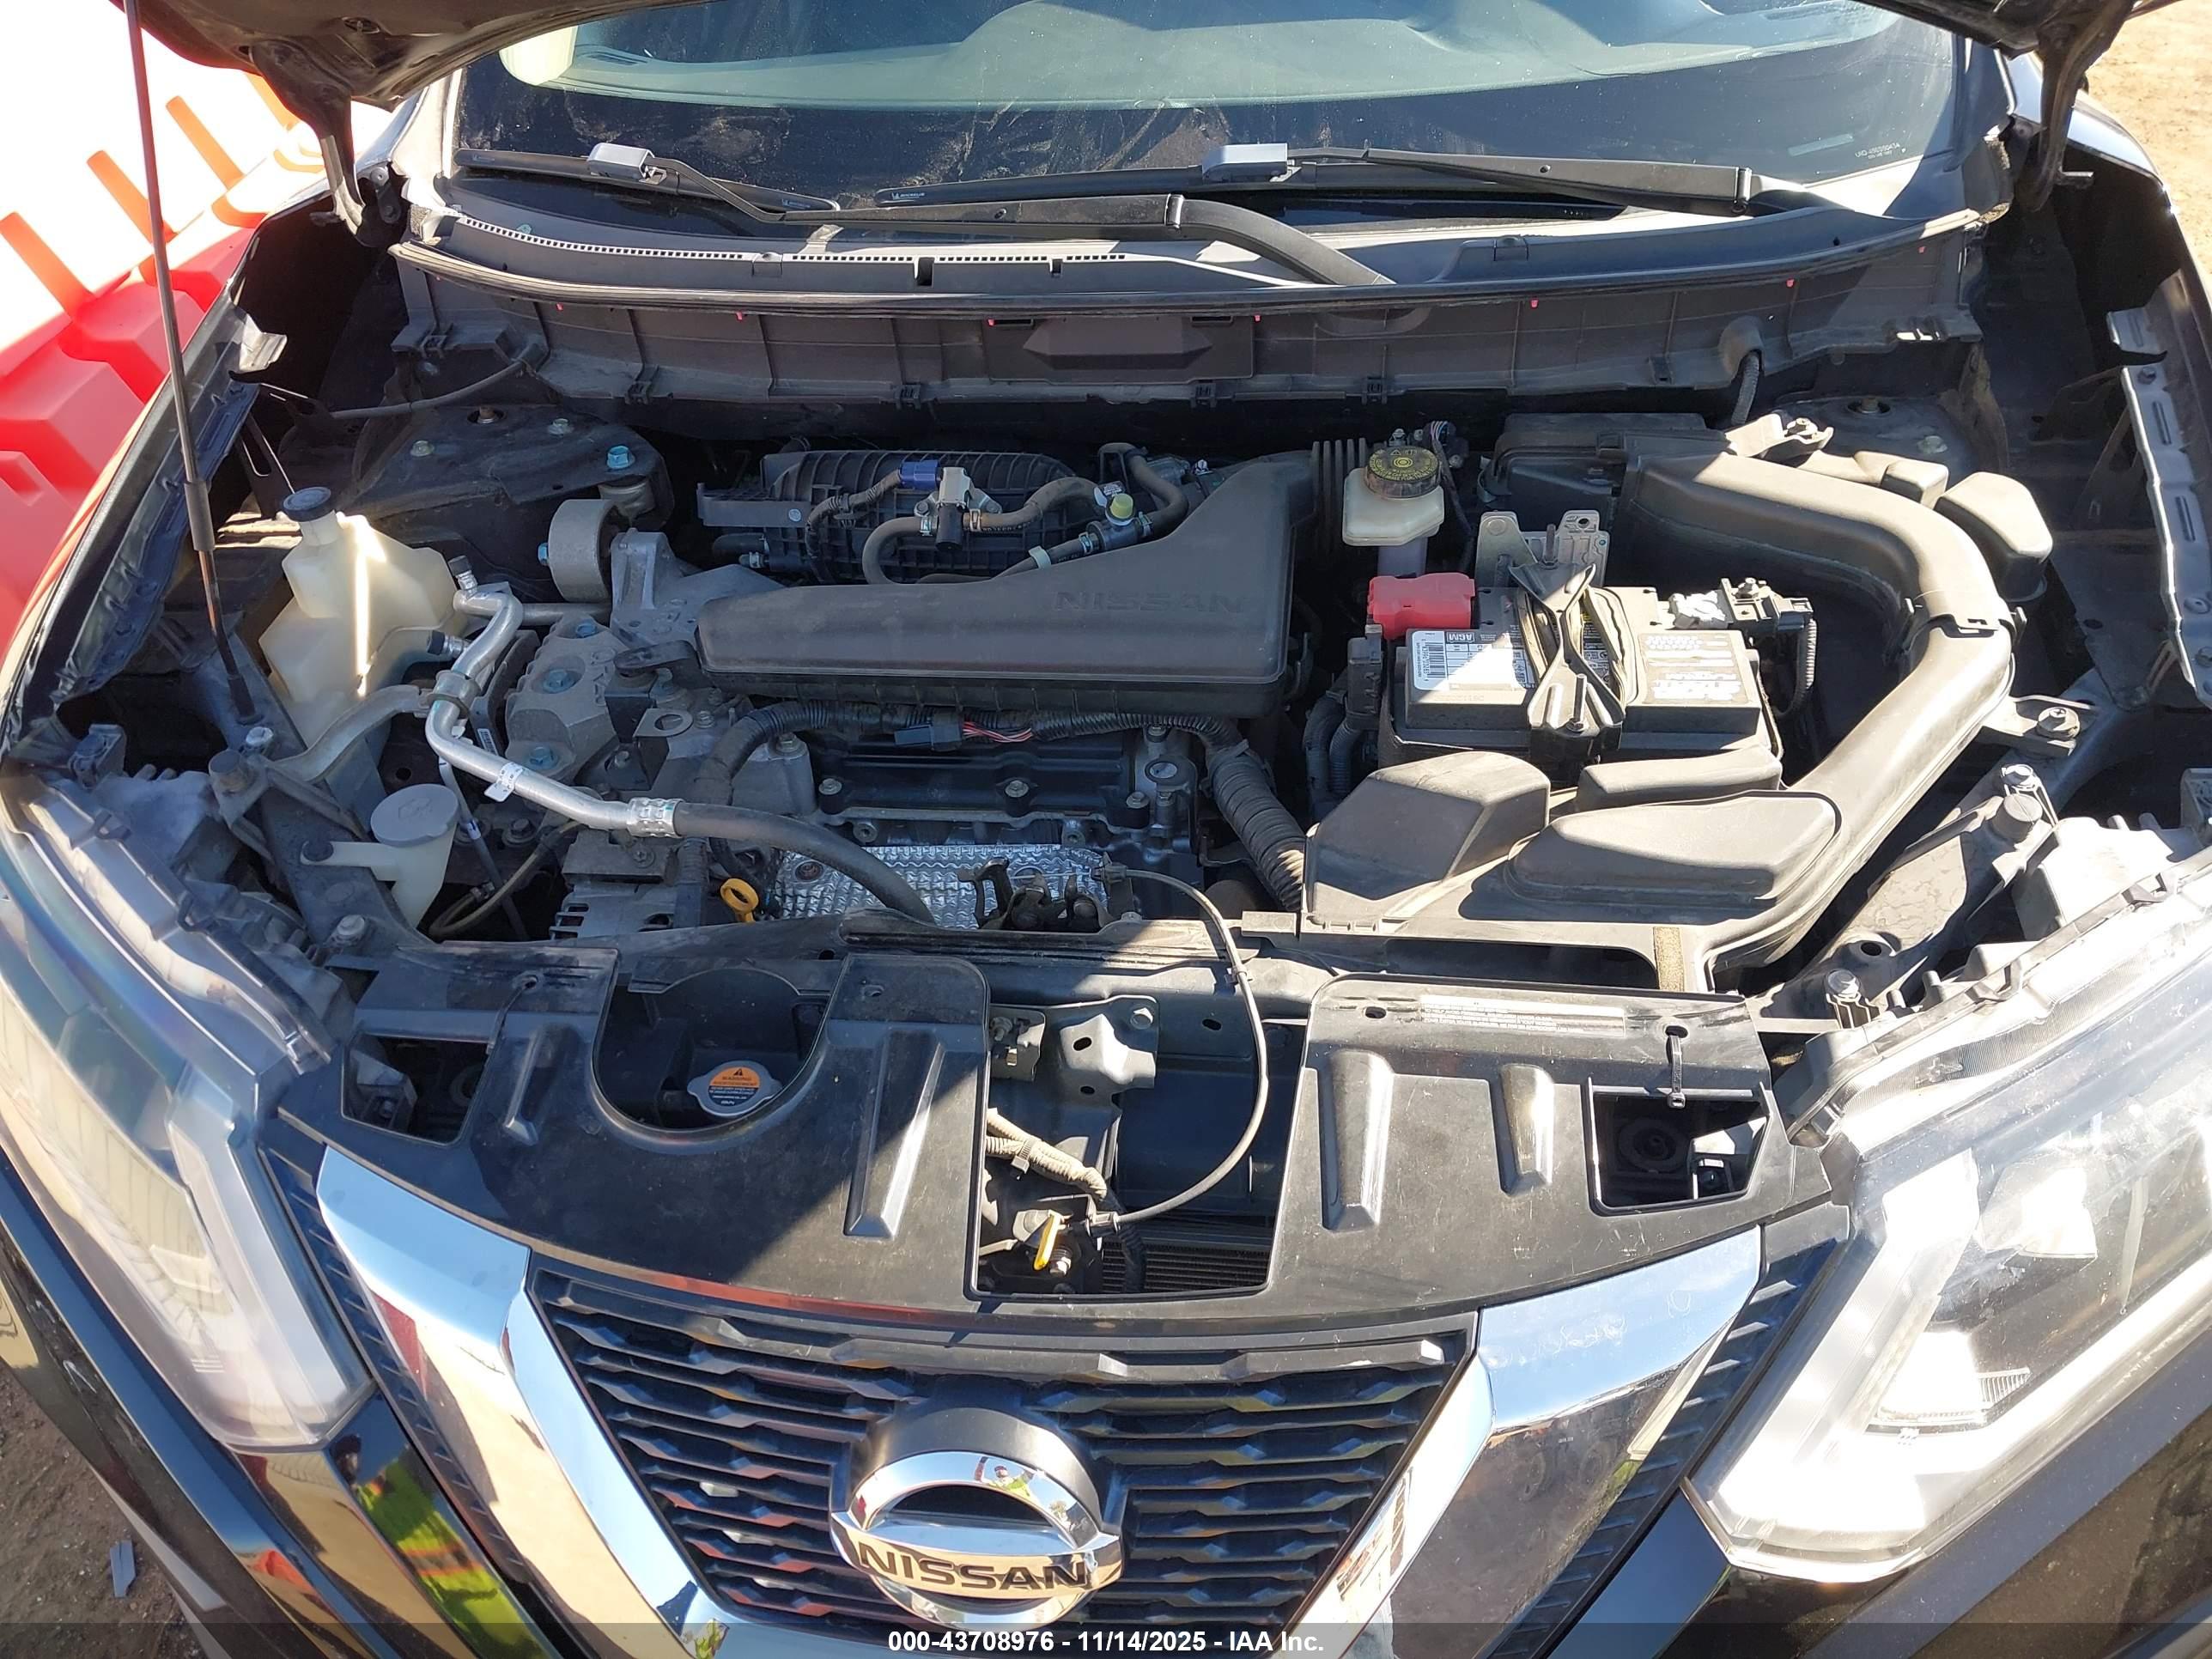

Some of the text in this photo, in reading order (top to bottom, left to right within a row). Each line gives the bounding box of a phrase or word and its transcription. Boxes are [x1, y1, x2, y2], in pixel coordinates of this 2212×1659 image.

[1054, 591, 1246, 614] NISSAN
[1449, 632, 1473, 641] AGM
[859, 1542, 1086, 1591] NISSAN
